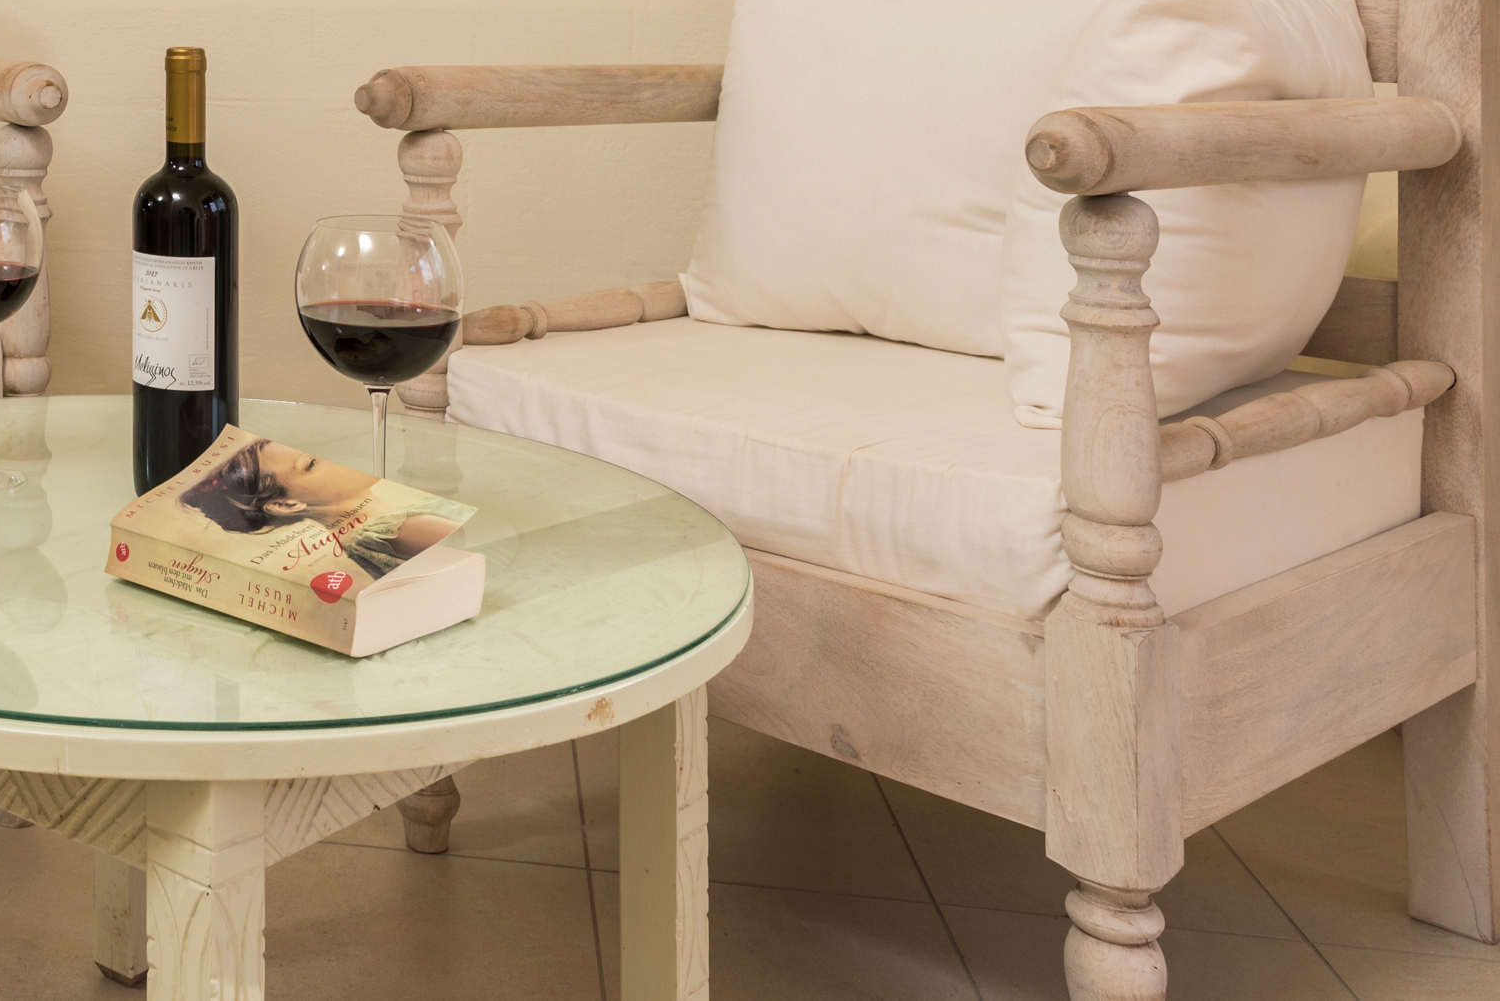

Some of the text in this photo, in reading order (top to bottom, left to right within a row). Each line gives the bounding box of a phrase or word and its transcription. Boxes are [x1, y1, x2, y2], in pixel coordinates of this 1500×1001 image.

[125, 436, 235, 518] MICHEL BUSSI
[309, 498, 373, 540] mit den blauen
[119, 542, 127, 556] atb
[250, 524, 316, 565] Das Mädchen
[282, 513, 368, 571] Augen
[148, 561, 193, 581] mit den blauen
[168, 553, 221, 585] Augen
[327, 571, 346, 590] atb
[164, 576, 208, 598] Das Mädchen
[247, 581, 292, 604] BUSSI
[239, 593, 298, 621] MICHEL
